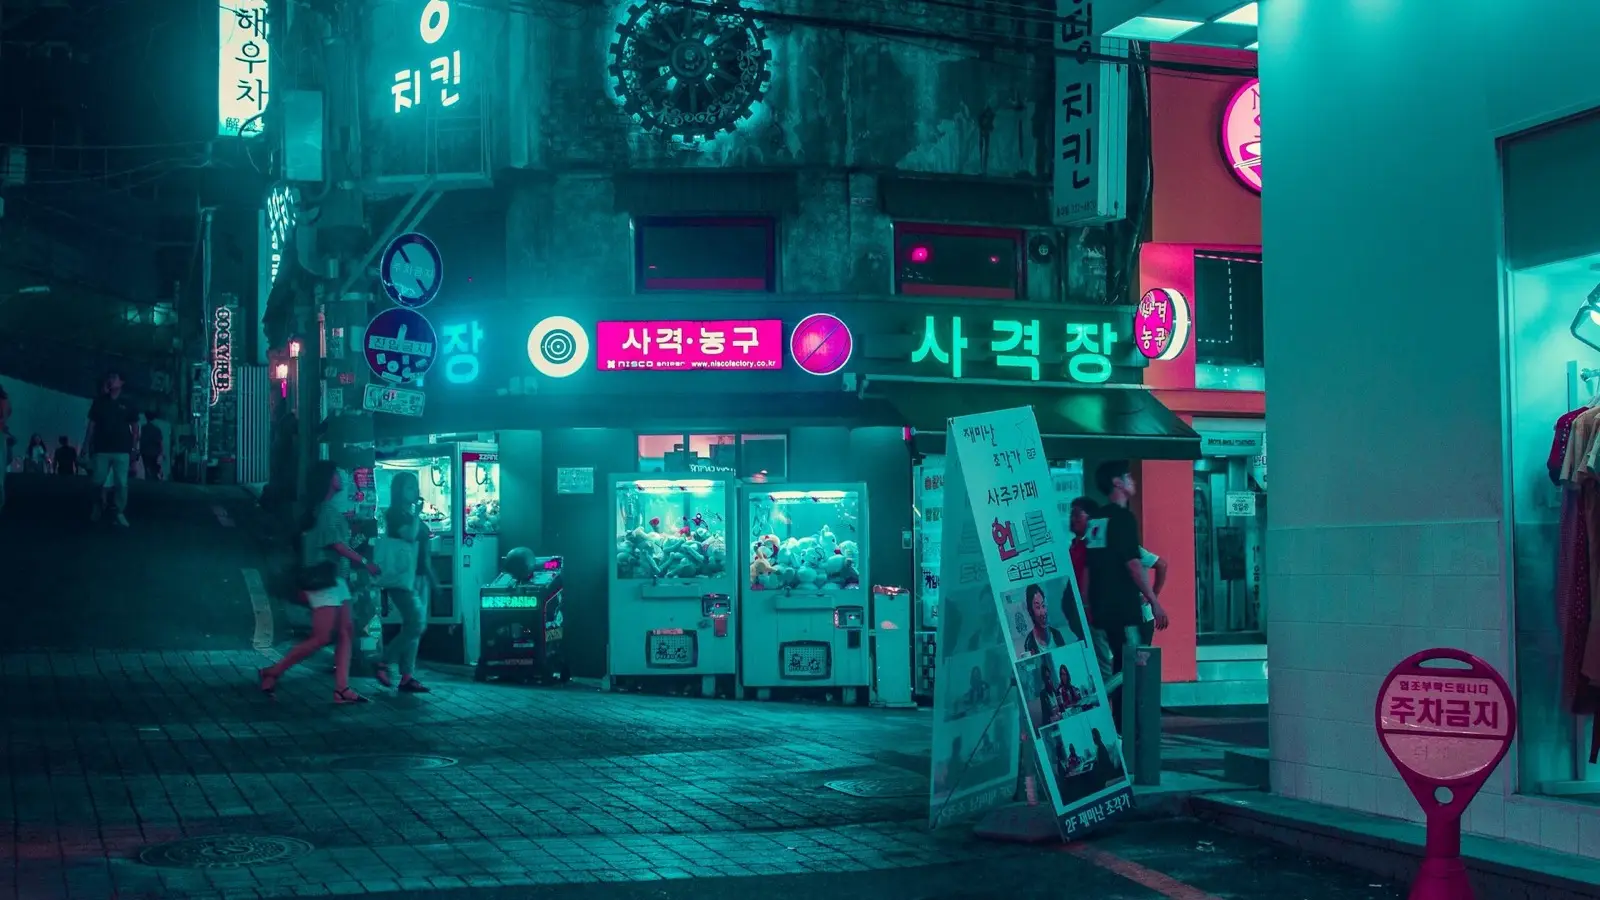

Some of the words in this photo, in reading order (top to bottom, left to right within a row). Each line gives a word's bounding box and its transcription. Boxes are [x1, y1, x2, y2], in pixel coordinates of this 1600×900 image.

[236, 8, 269, 111] 해우차
[391, 49, 461, 114] 치킨
[1062, 82, 1093, 190] 치킨
[1141, 300, 1167, 323] 사격
[374, 337, 428, 354] 진입금지
[442, 320, 484, 384] 장
[622, 327, 759, 355] 사격·농구
[911, 316, 1118, 383] 사격장
[1141, 325, 1166, 349] 농구
[992, 450, 1021, 473] 조각가
[987, 480, 1039, 506] 사주카페
[1006, 552, 1058, 582] 슬램덩크
[1390, 696, 1499, 730] 주차금지
[1065, 816, 1077, 833] 2F
[1078, 804, 1105, 827] 재미난
[1105, 793, 1131, 815] 조각가
